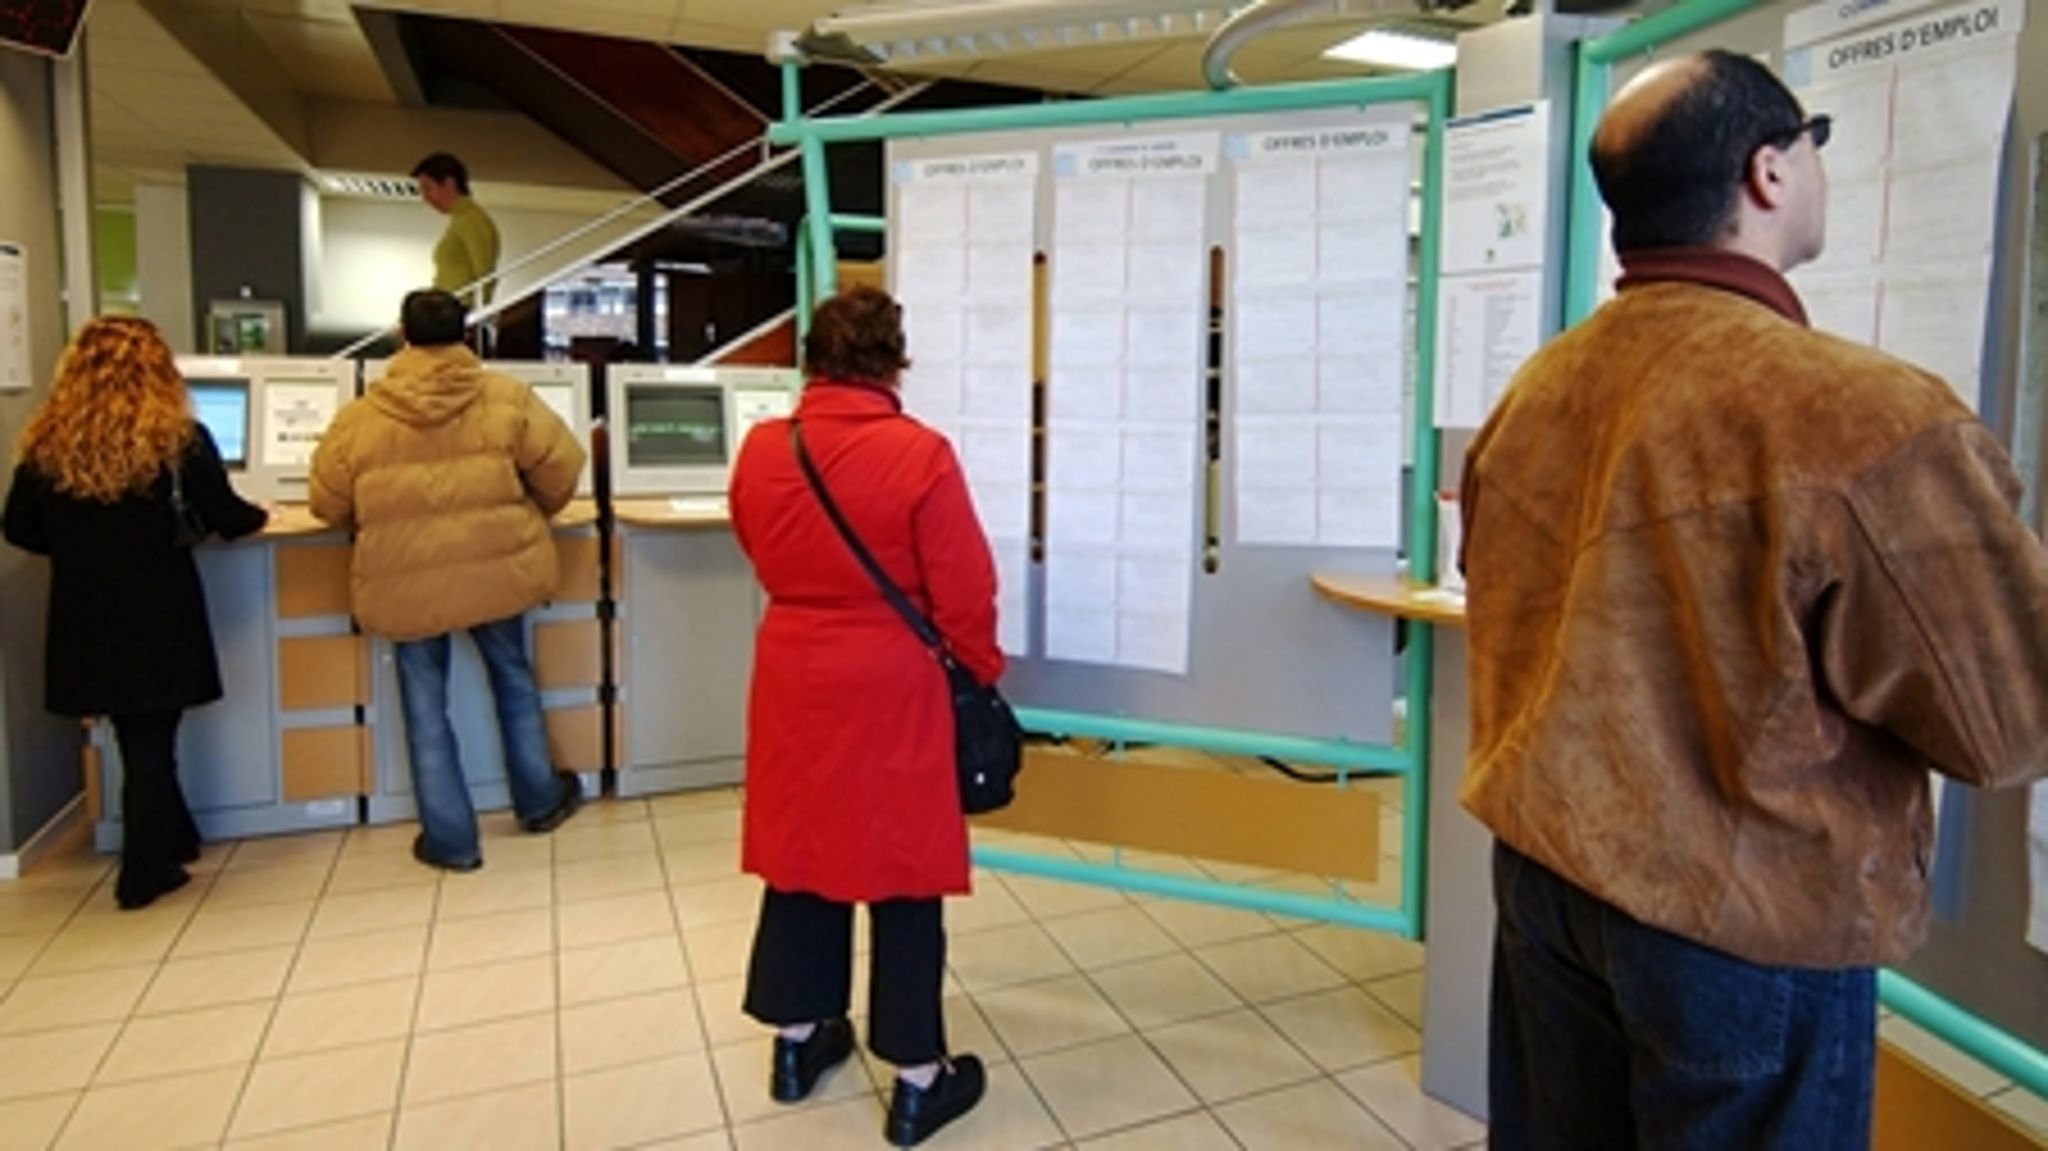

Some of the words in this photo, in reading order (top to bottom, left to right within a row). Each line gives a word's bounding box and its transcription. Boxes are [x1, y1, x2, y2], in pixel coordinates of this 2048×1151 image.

[1828, 32, 1895, 69] OFFRES
[1900, 6, 1999, 51] D'EMPLOI
[1263, 135, 1316, 151] OFFRES
[1319, 130, 1388, 150] D'EMPLOI
